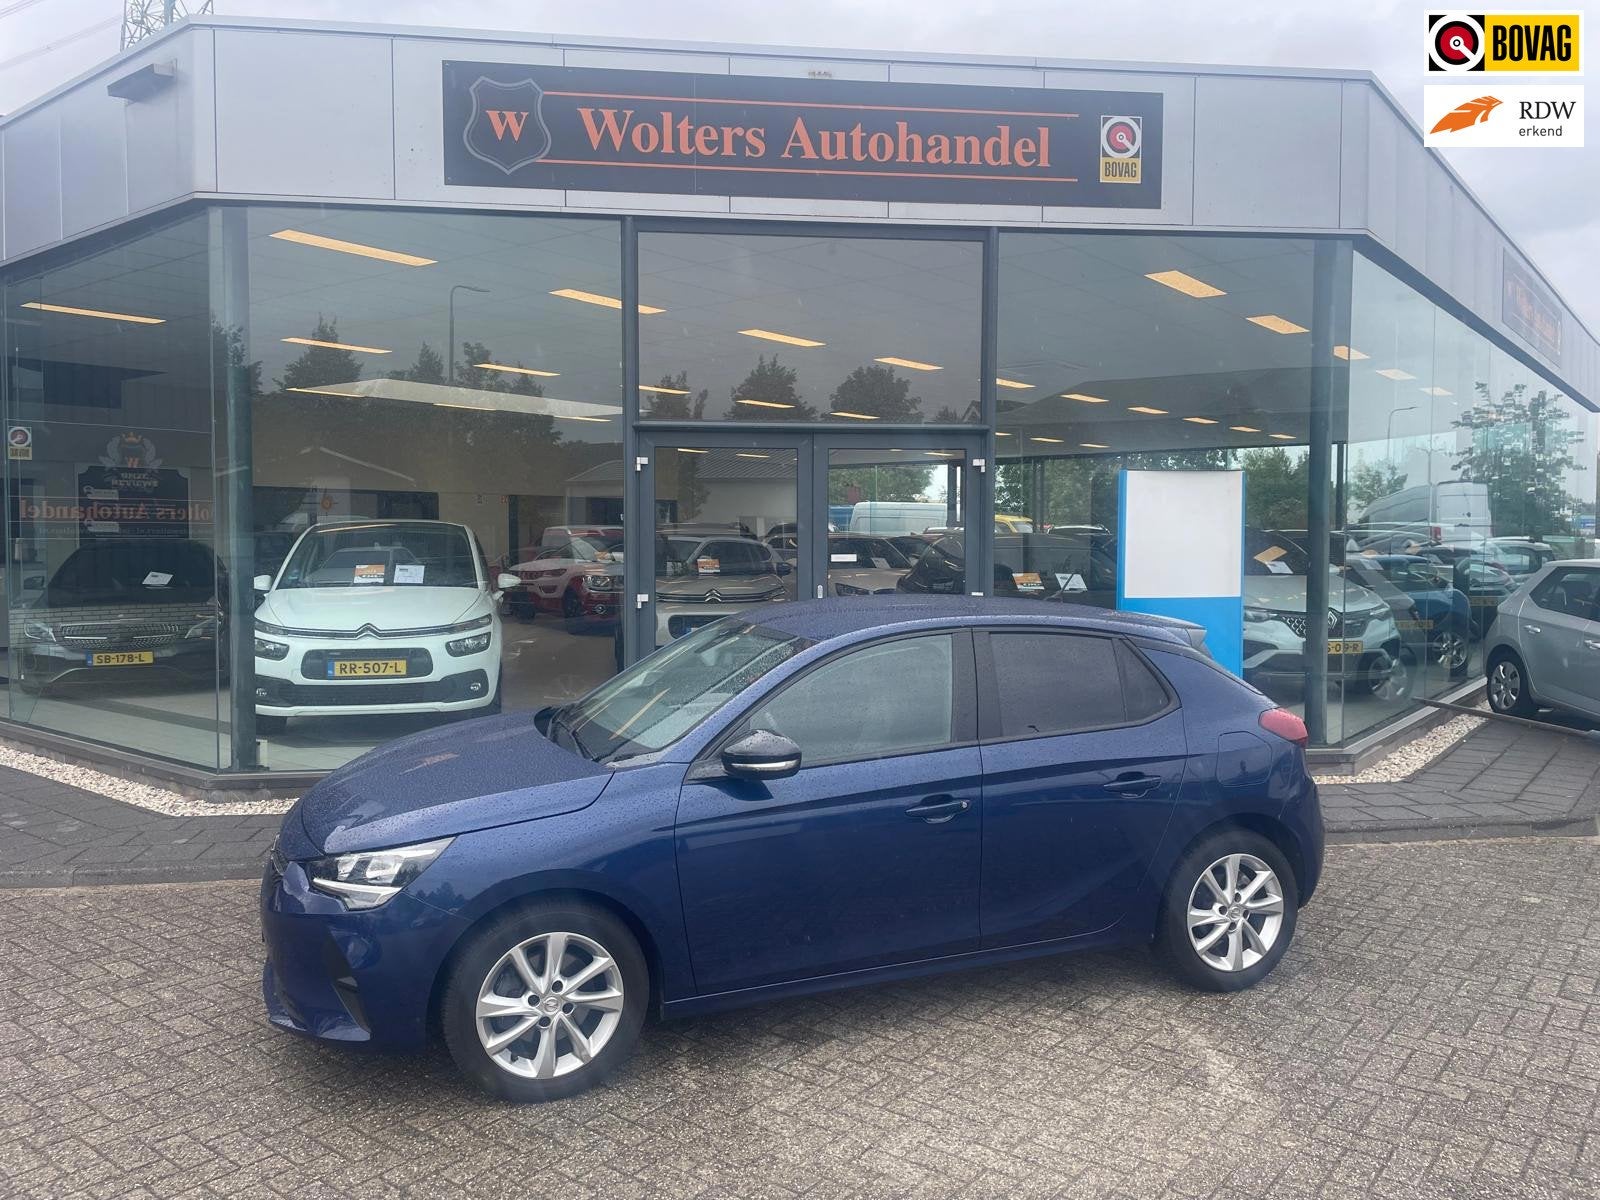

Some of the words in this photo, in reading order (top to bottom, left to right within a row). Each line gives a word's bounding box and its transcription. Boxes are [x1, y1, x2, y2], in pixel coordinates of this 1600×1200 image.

[486, 109, 529, 144] W
[577, 107, 766, 158] Wolters
[781, 116, 1051, 167] Autohandel
[1104, 161, 1137, 178] BOVAG
[96, 653, 145, 664] SB-178-L
[339, 661, 402, 674] RR-507-L
